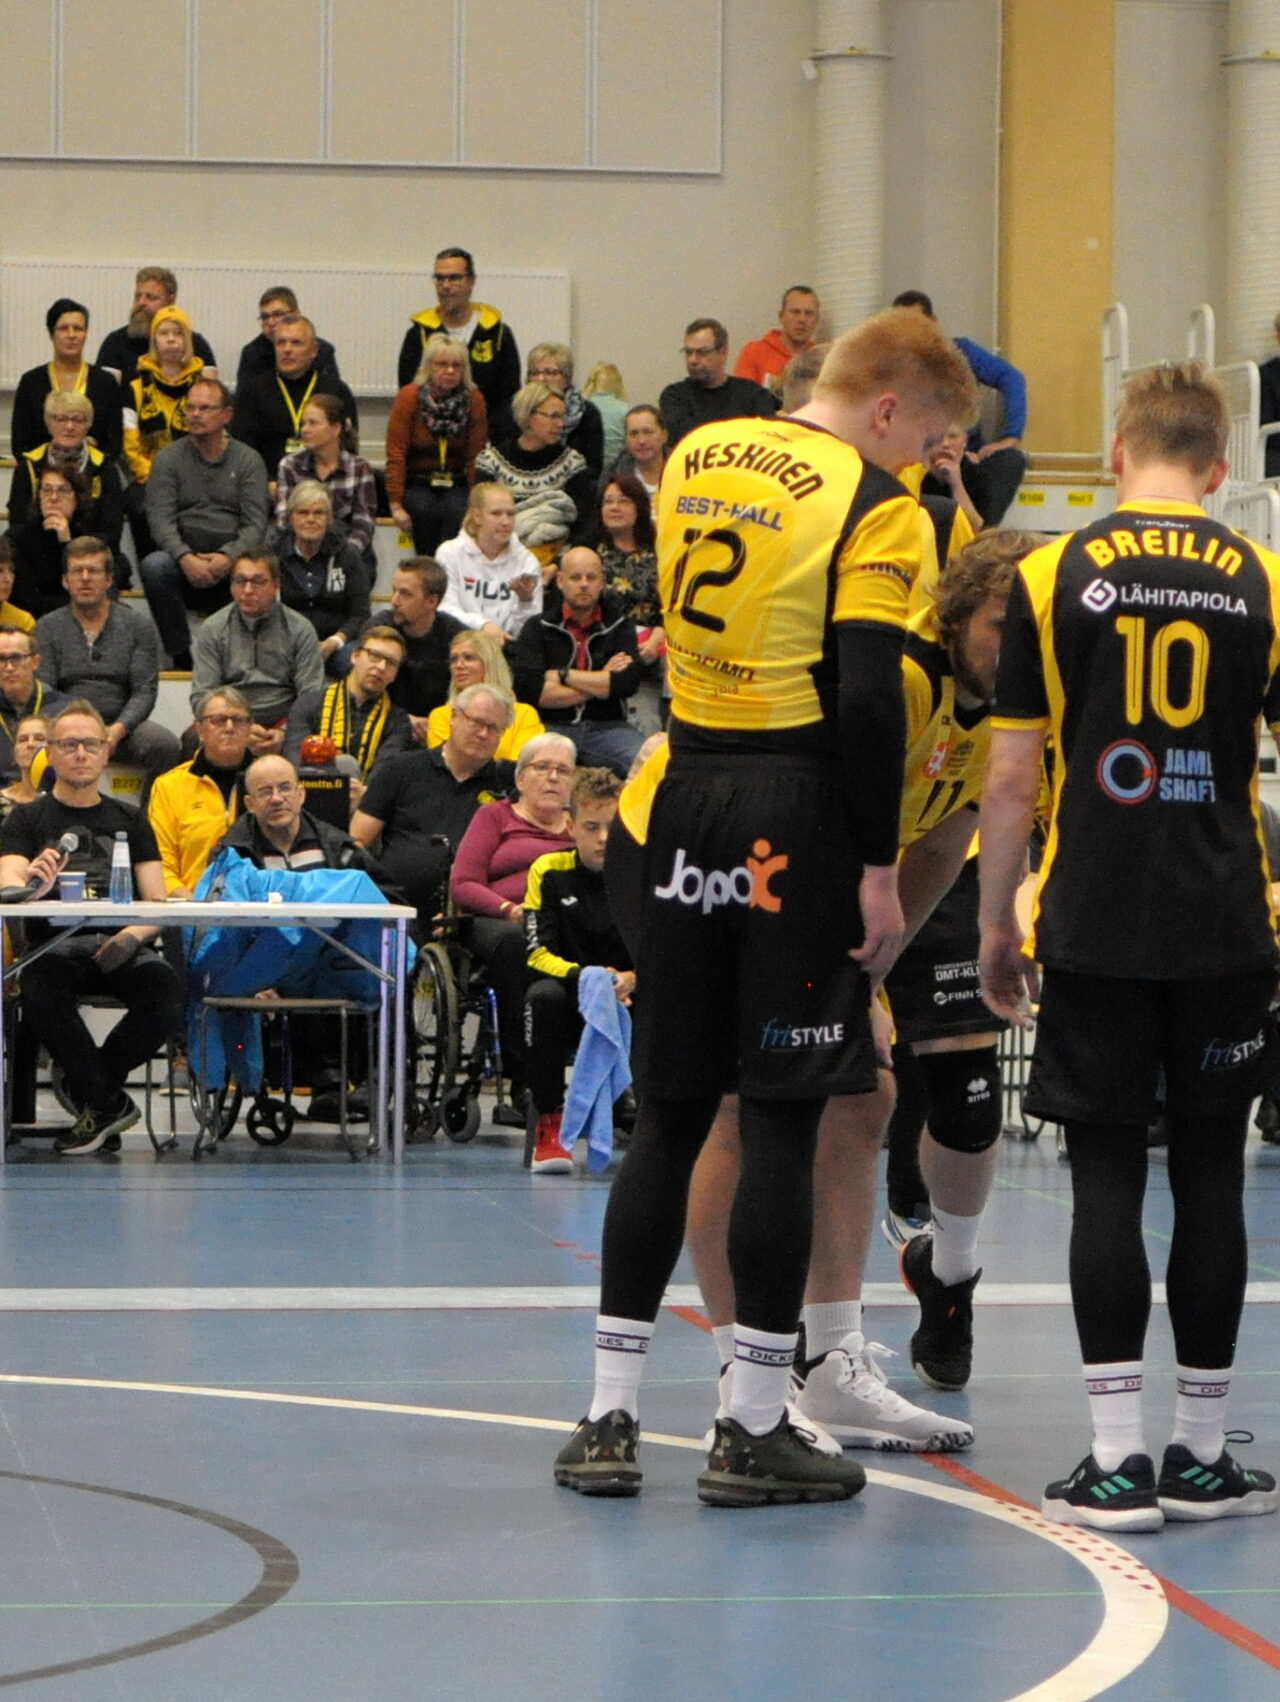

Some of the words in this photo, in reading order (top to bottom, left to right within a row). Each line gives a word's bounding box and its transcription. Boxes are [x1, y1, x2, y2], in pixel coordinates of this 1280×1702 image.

[676, 495, 783, 531] BEST-HALL
[1084, 529, 1243, 577] BREILIN
[667, 527, 747, 634] 12
[1120, 583, 1248, 615] LÄHITAPIOLA
[1115, 616, 1210, 728] 10
